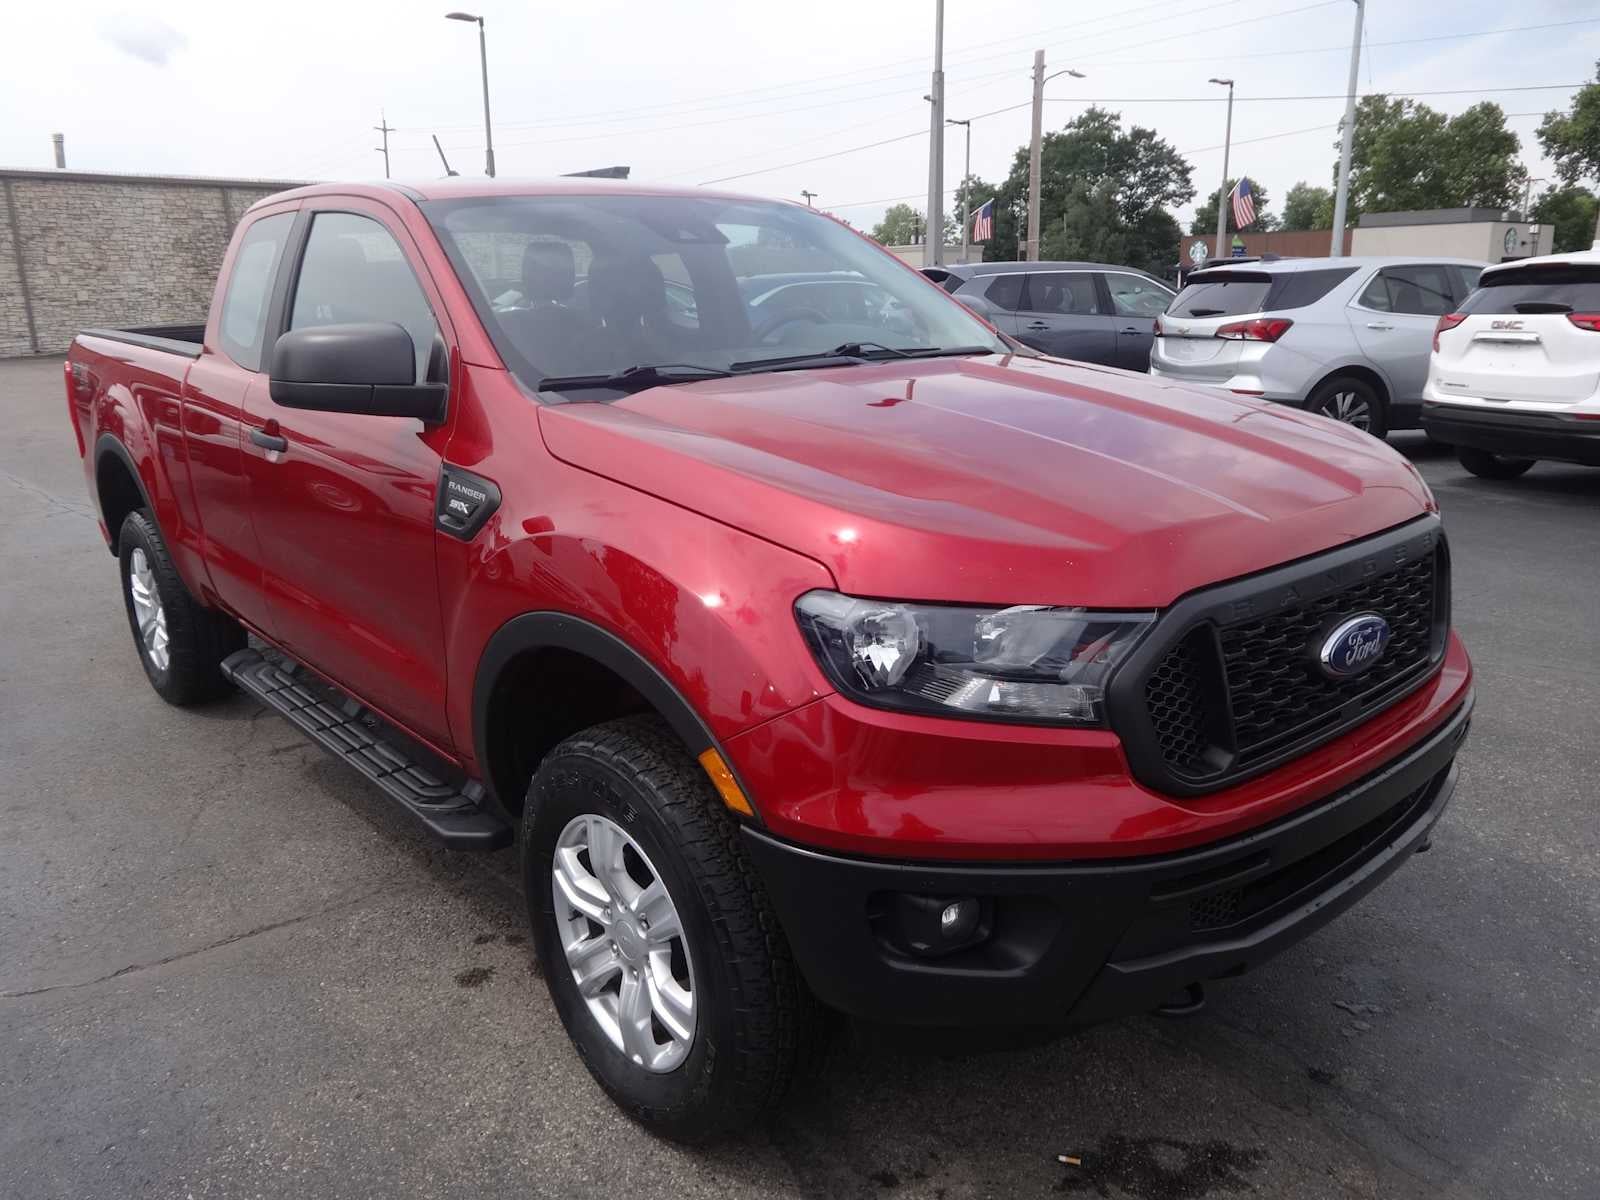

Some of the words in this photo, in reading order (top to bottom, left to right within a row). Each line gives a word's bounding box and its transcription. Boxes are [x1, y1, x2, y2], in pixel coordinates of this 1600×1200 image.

[1491, 320, 1524, 330] GMC
[448, 481, 486, 502] RANGER
[449, 499, 469, 514] STX
[1345, 631, 1382, 667] Ford
